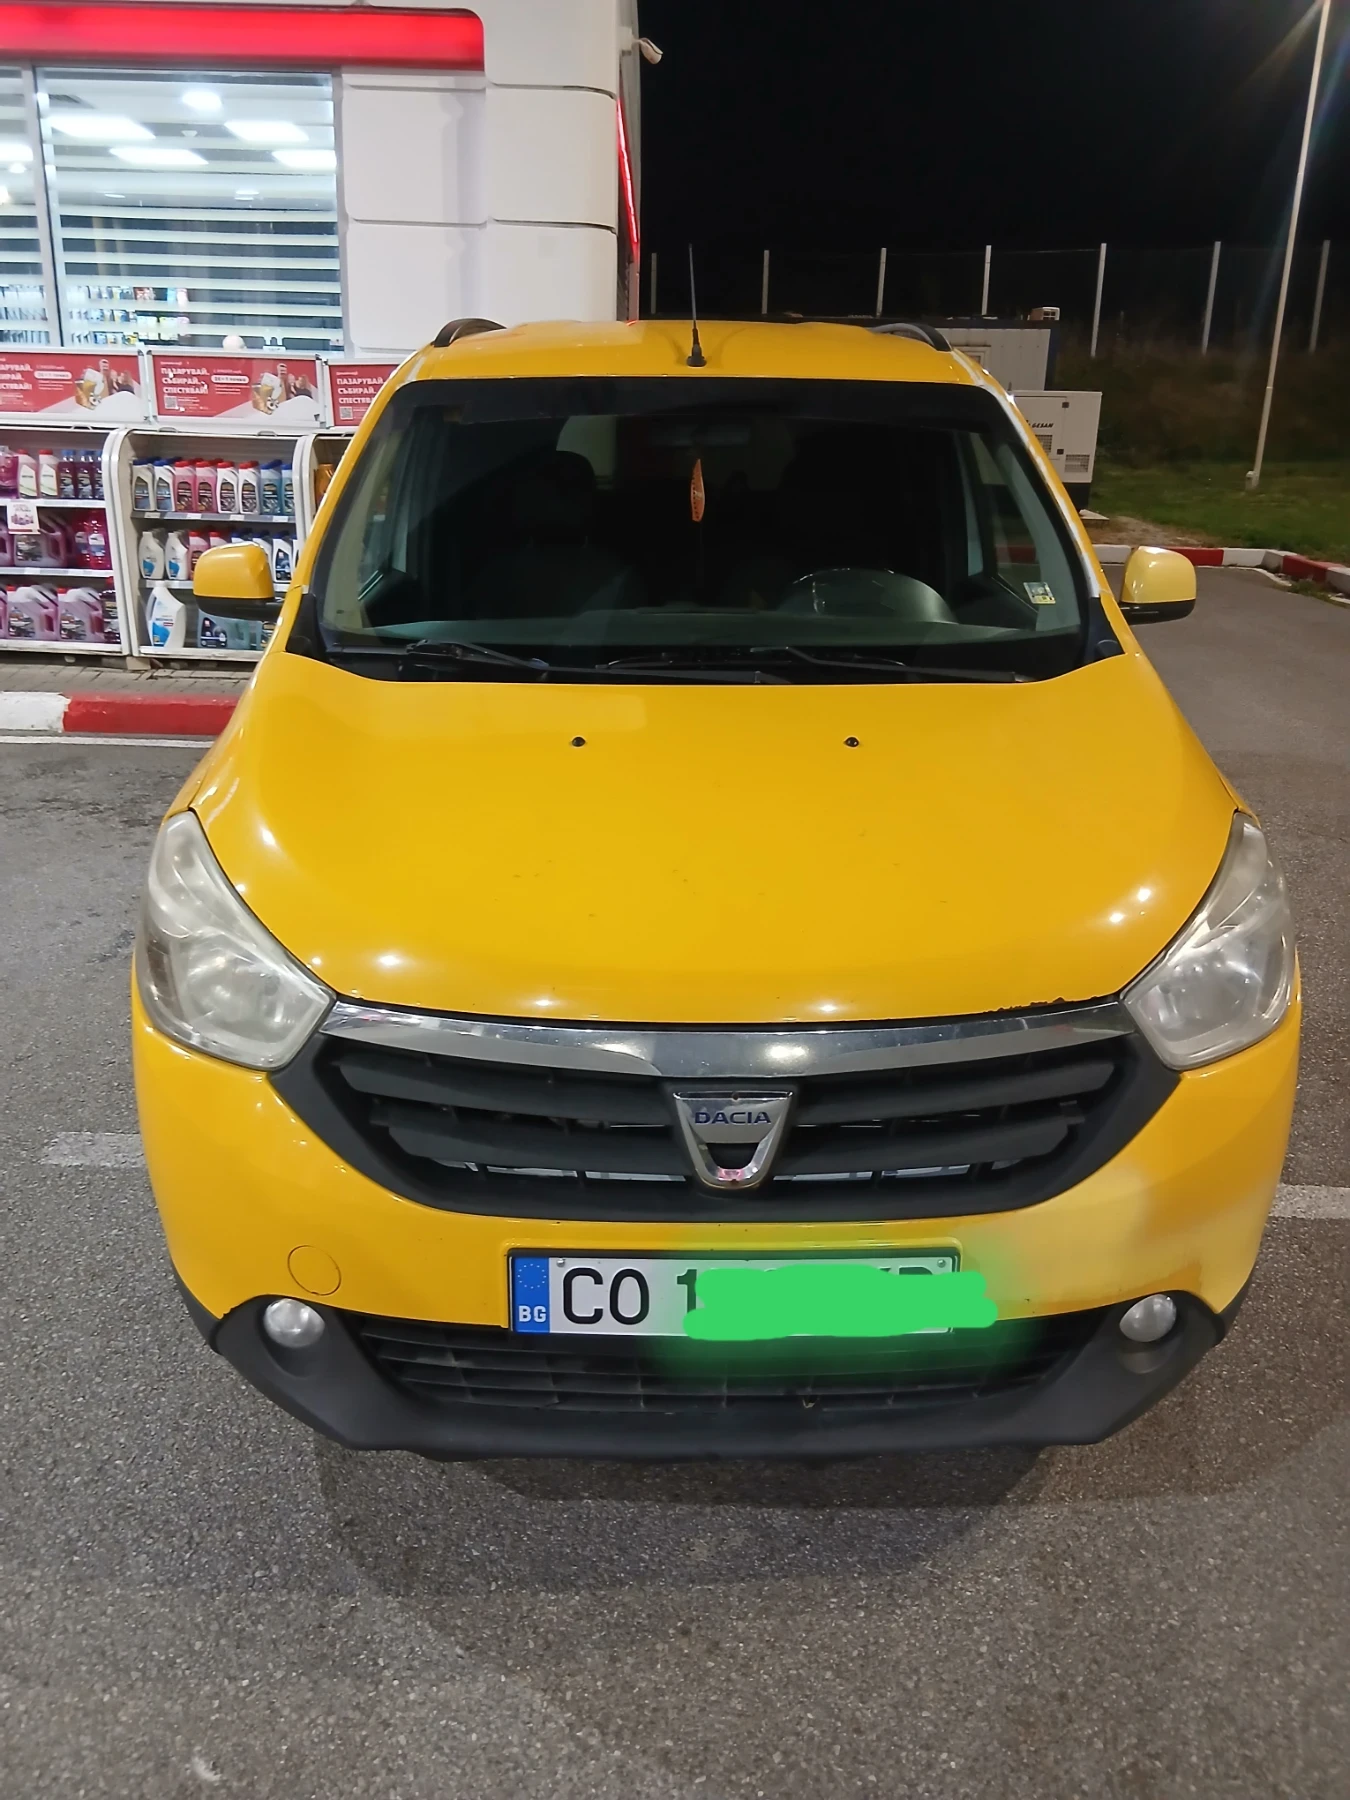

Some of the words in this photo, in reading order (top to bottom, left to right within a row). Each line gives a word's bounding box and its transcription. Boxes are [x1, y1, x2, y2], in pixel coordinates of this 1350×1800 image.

[695, 1111, 772, 1124] DACIA
[563, 1267, 650, 1325] CO
[518, 1305, 547, 1323] BG
